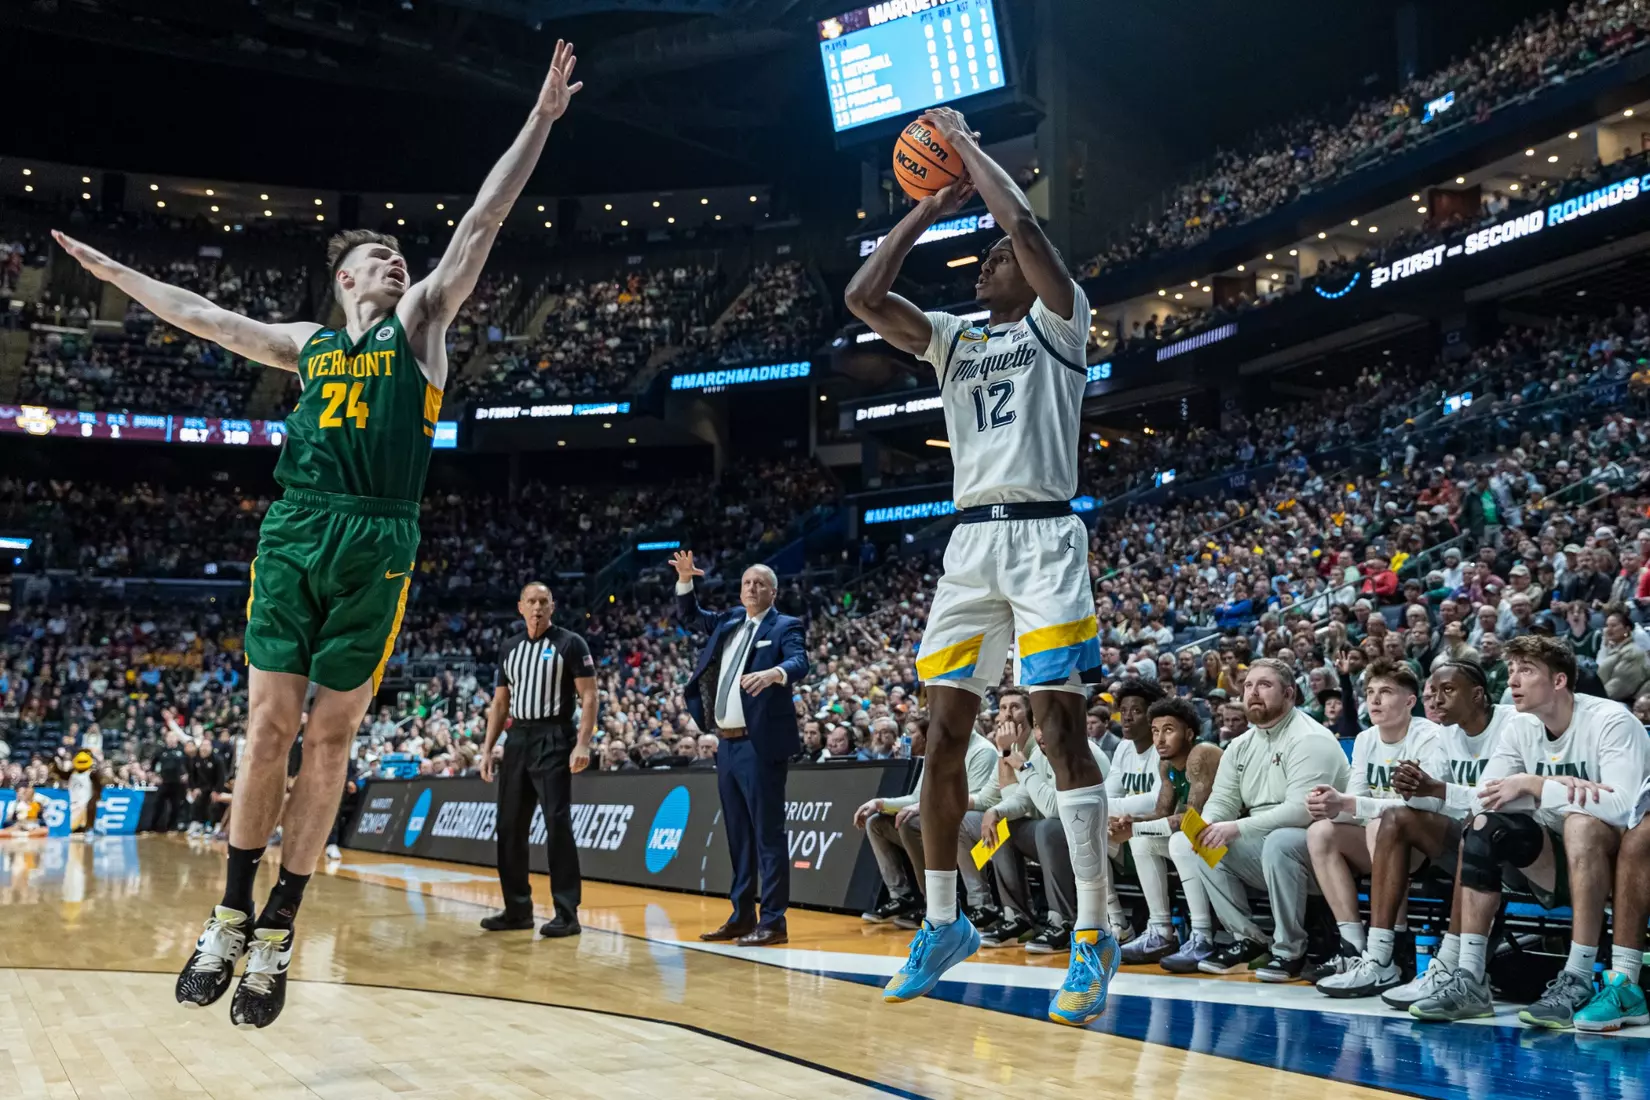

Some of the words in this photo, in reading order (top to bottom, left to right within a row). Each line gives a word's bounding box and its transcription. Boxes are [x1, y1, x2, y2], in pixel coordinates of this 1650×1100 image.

[868, 0, 957, 27] MARQUE
[828, 53, 837, 67] 1
[979, 7, 988, 23] 1
[945, 34, 954, 49] 1
[831, 82, 845, 99] 11
[953, 80, 962, 95] 1
[971, 75, 980, 90] 1
[905, 122, 949, 163] Wilson
[896, 148, 929, 180] NCAA
[1391, 244, 1447, 281] FIRST
[1464, 209, 1544, 256] SECOND
[1547, 176, 1641, 227] ROUNDS
[671, 361, 811, 390] #MARCHMADNESS
[951, 343, 1036, 382] Maquette
[319, 381, 369, 429] 24
[488, 405, 521, 419] FIRST
[530, 403, 573, 418] SECOND
[868, 403, 898, 419] FIRST
[972, 379, 1017, 432] 12
[110, 424, 121, 438] 1
[864, 500, 956, 524] #MARCHMAD
[991, 504, 1009, 519] AL
[1367, 762, 1398, 791] UV
[784, 801, 833, 821] RIOTT
[431, 801, 498, 841] CELEBRATES
[569, 804, 635, 850] THLETES
[647, 827, 684, 851] NCAA
[786, 830, 838, 870] VOY
